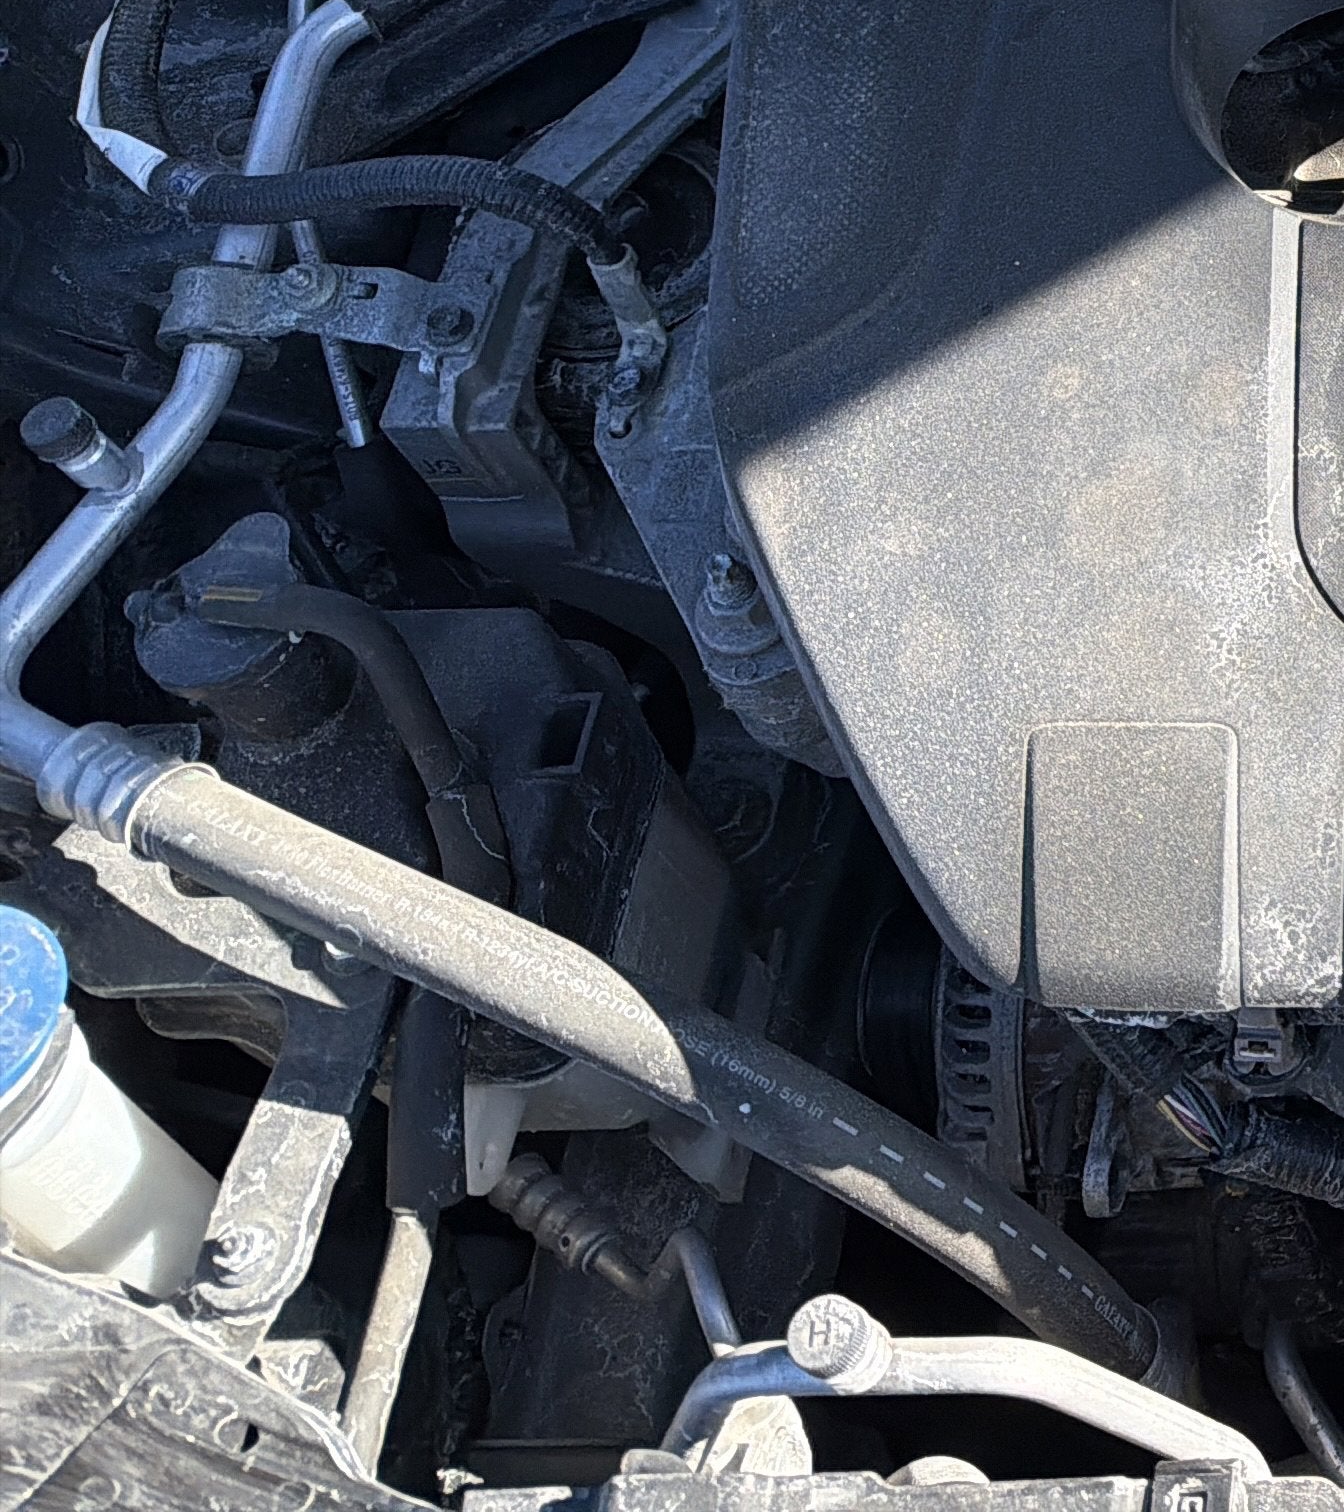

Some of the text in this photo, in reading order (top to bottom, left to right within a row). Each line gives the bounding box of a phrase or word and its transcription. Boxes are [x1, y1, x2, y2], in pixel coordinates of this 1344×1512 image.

[572, 979, 660, 1028] SUCTION
[710, 1050, 777, 1095] (16mm)
[778, 1086, 807, 1108] 5/8
[807, 1101, 824, 1119] in
[808, 1318, 832, 1348] H
